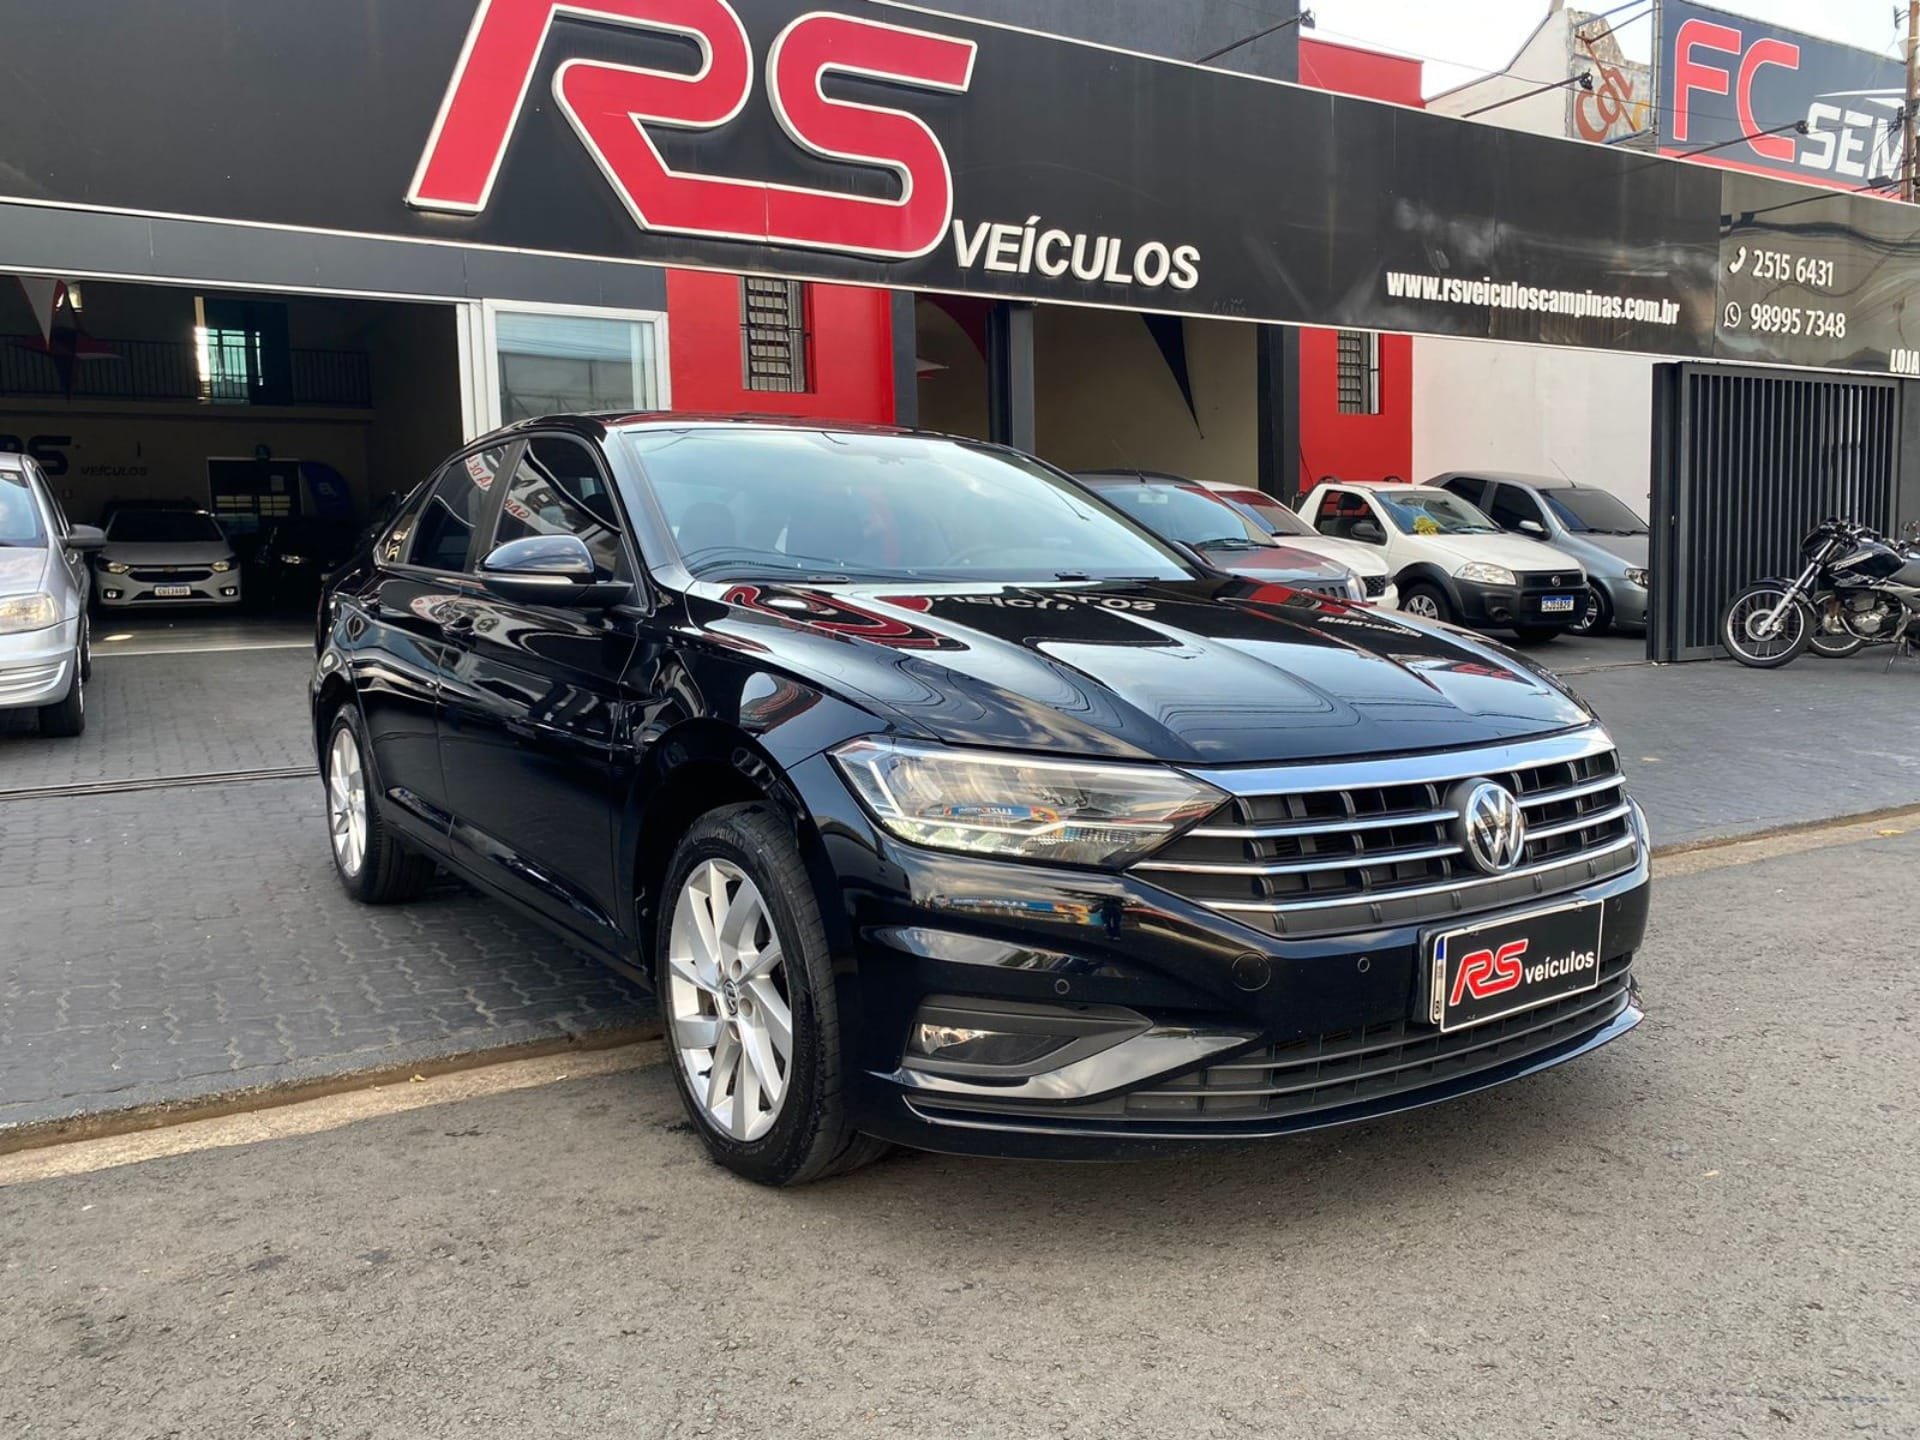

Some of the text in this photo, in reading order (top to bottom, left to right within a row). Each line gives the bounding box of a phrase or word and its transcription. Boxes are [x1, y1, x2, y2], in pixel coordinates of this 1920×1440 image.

[1673, 18, 1800, 163] FC
[406, 0, 1201, 289] RS VEÍCULOS
[1386, 271, 1681, 325] www.rsveiculoscampinas.com.br
[1752, 249, 1834, 288] 2515 6431
[1750, 303, 1847, 338] 98995 7348
[1449, 938, 1595, 1006] RS veículos
